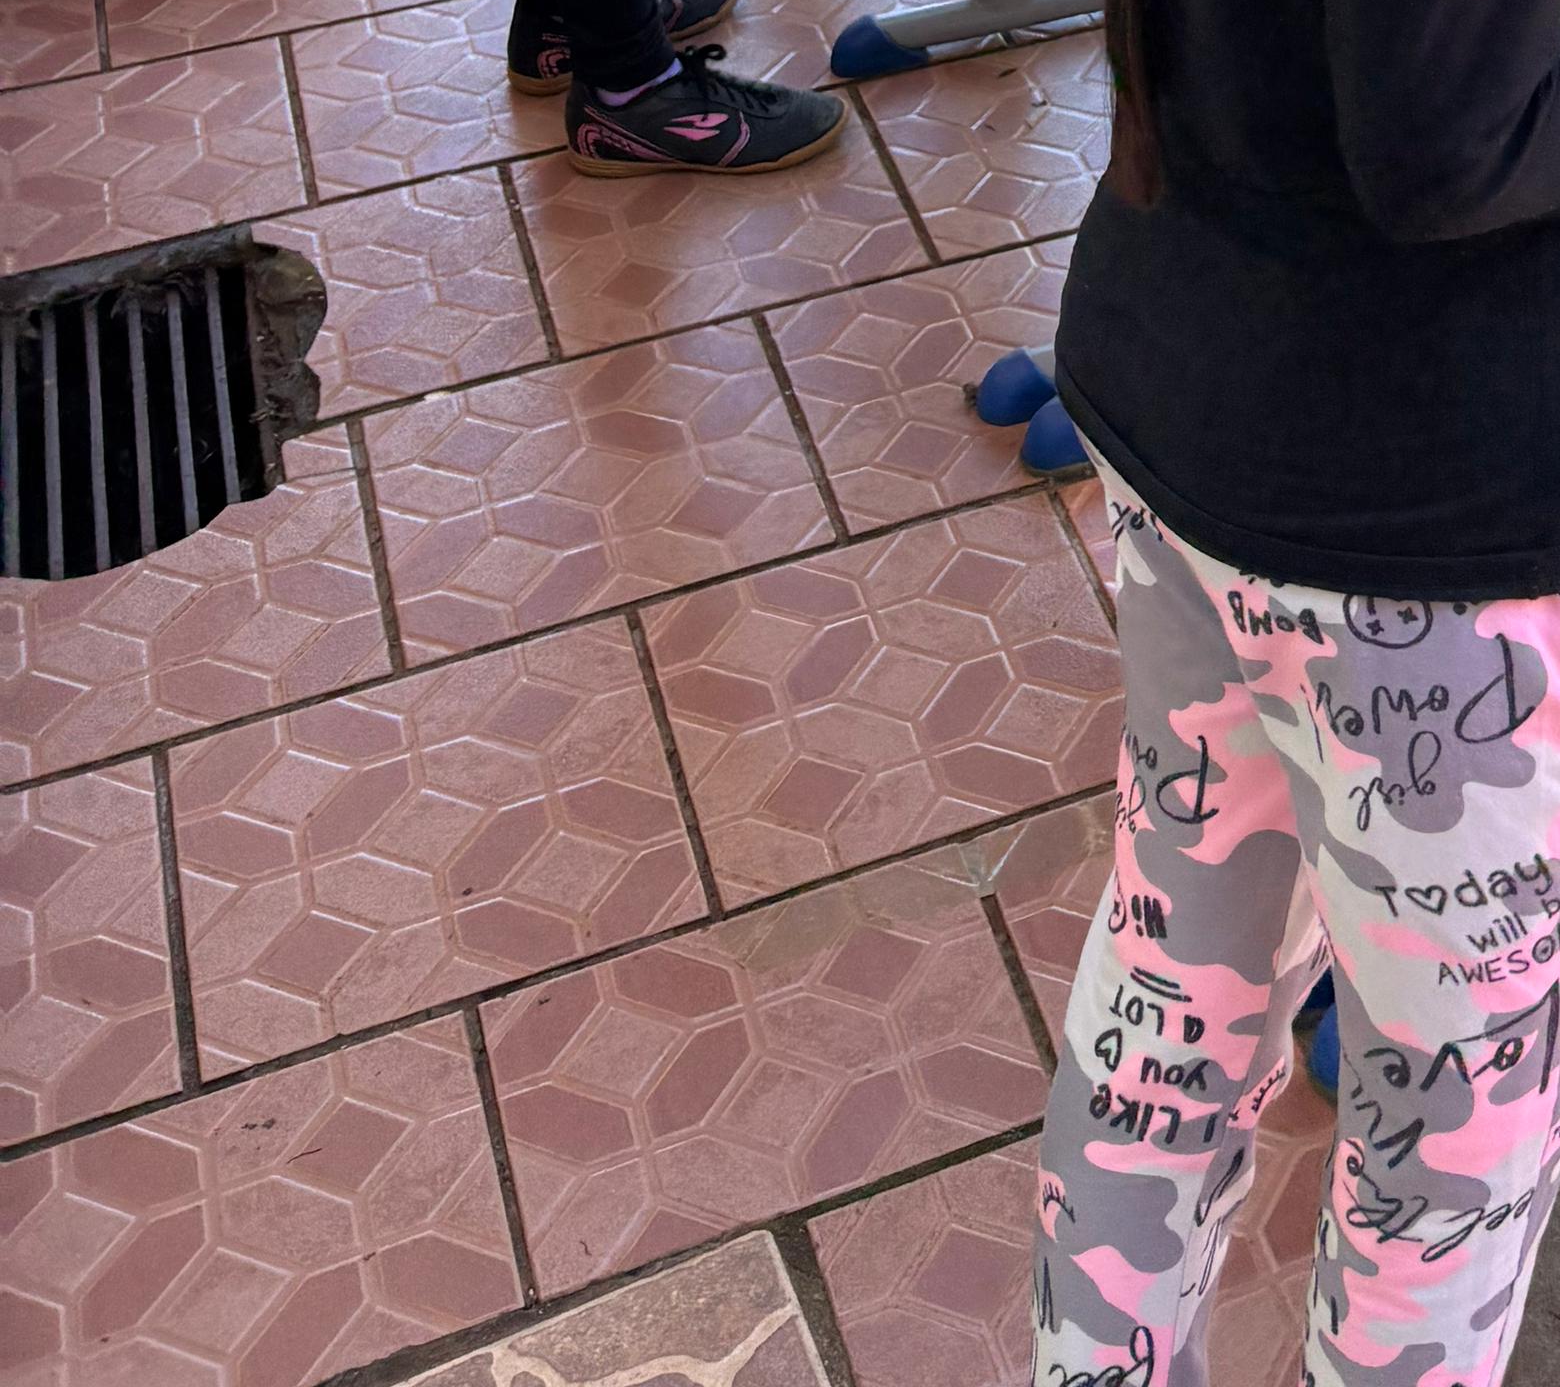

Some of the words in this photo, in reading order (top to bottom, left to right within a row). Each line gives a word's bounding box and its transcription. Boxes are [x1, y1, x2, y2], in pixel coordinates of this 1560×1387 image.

[1315, 632, 1536, 745] Power
[1348, 730, 1442, 832] girl
[1465, 911, 1528, 954] will
[1109, 984, 1165, 1037] LOT
[1363, 979, 1560, 1095] Love
[1421, 1188, 1535, 1263] eel
